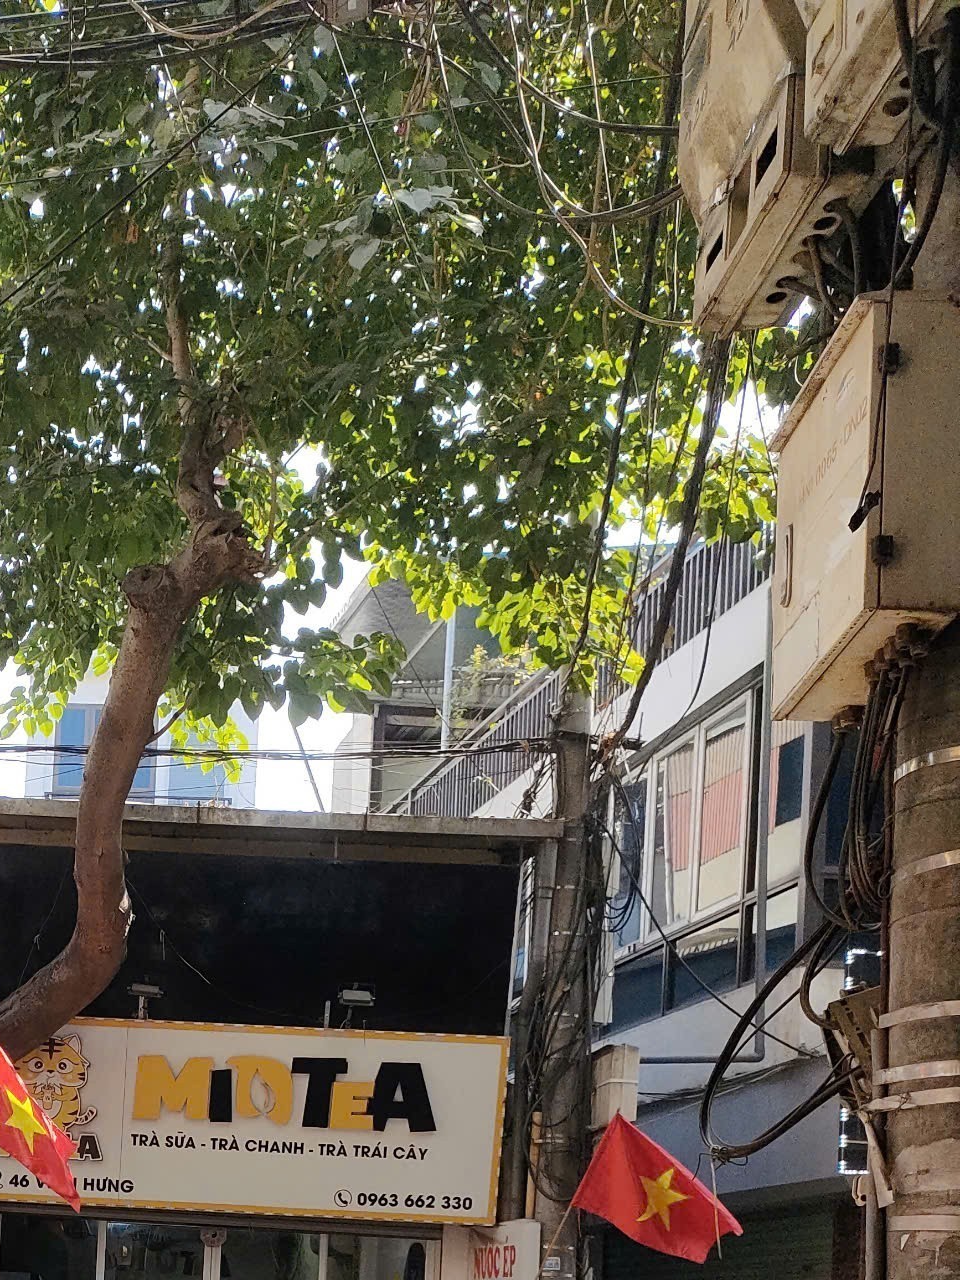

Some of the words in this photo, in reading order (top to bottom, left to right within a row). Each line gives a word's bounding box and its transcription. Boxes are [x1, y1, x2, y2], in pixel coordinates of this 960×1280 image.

[131, 1131, 160, 1148] TRÀ
[165, 1130, 196, 1150] SỮA
[210, 1135, 240, 1152] TRÀ
[244, 1139, 304, 1155] CHANH
[318, 1139, 348, 1157] TRÀ
[353, 1140, 388, 1159] TRÁI
[392, 1142, 428, 1161] CÂY
[9, 1174, 30, 1188] 46
[83, 1176, 134, 1193] HƯNG
[356, 1192, 398, 1208] 0963
[404, 1194, 436, 1209] 662
[440, 1195, 473, 1211] 330
